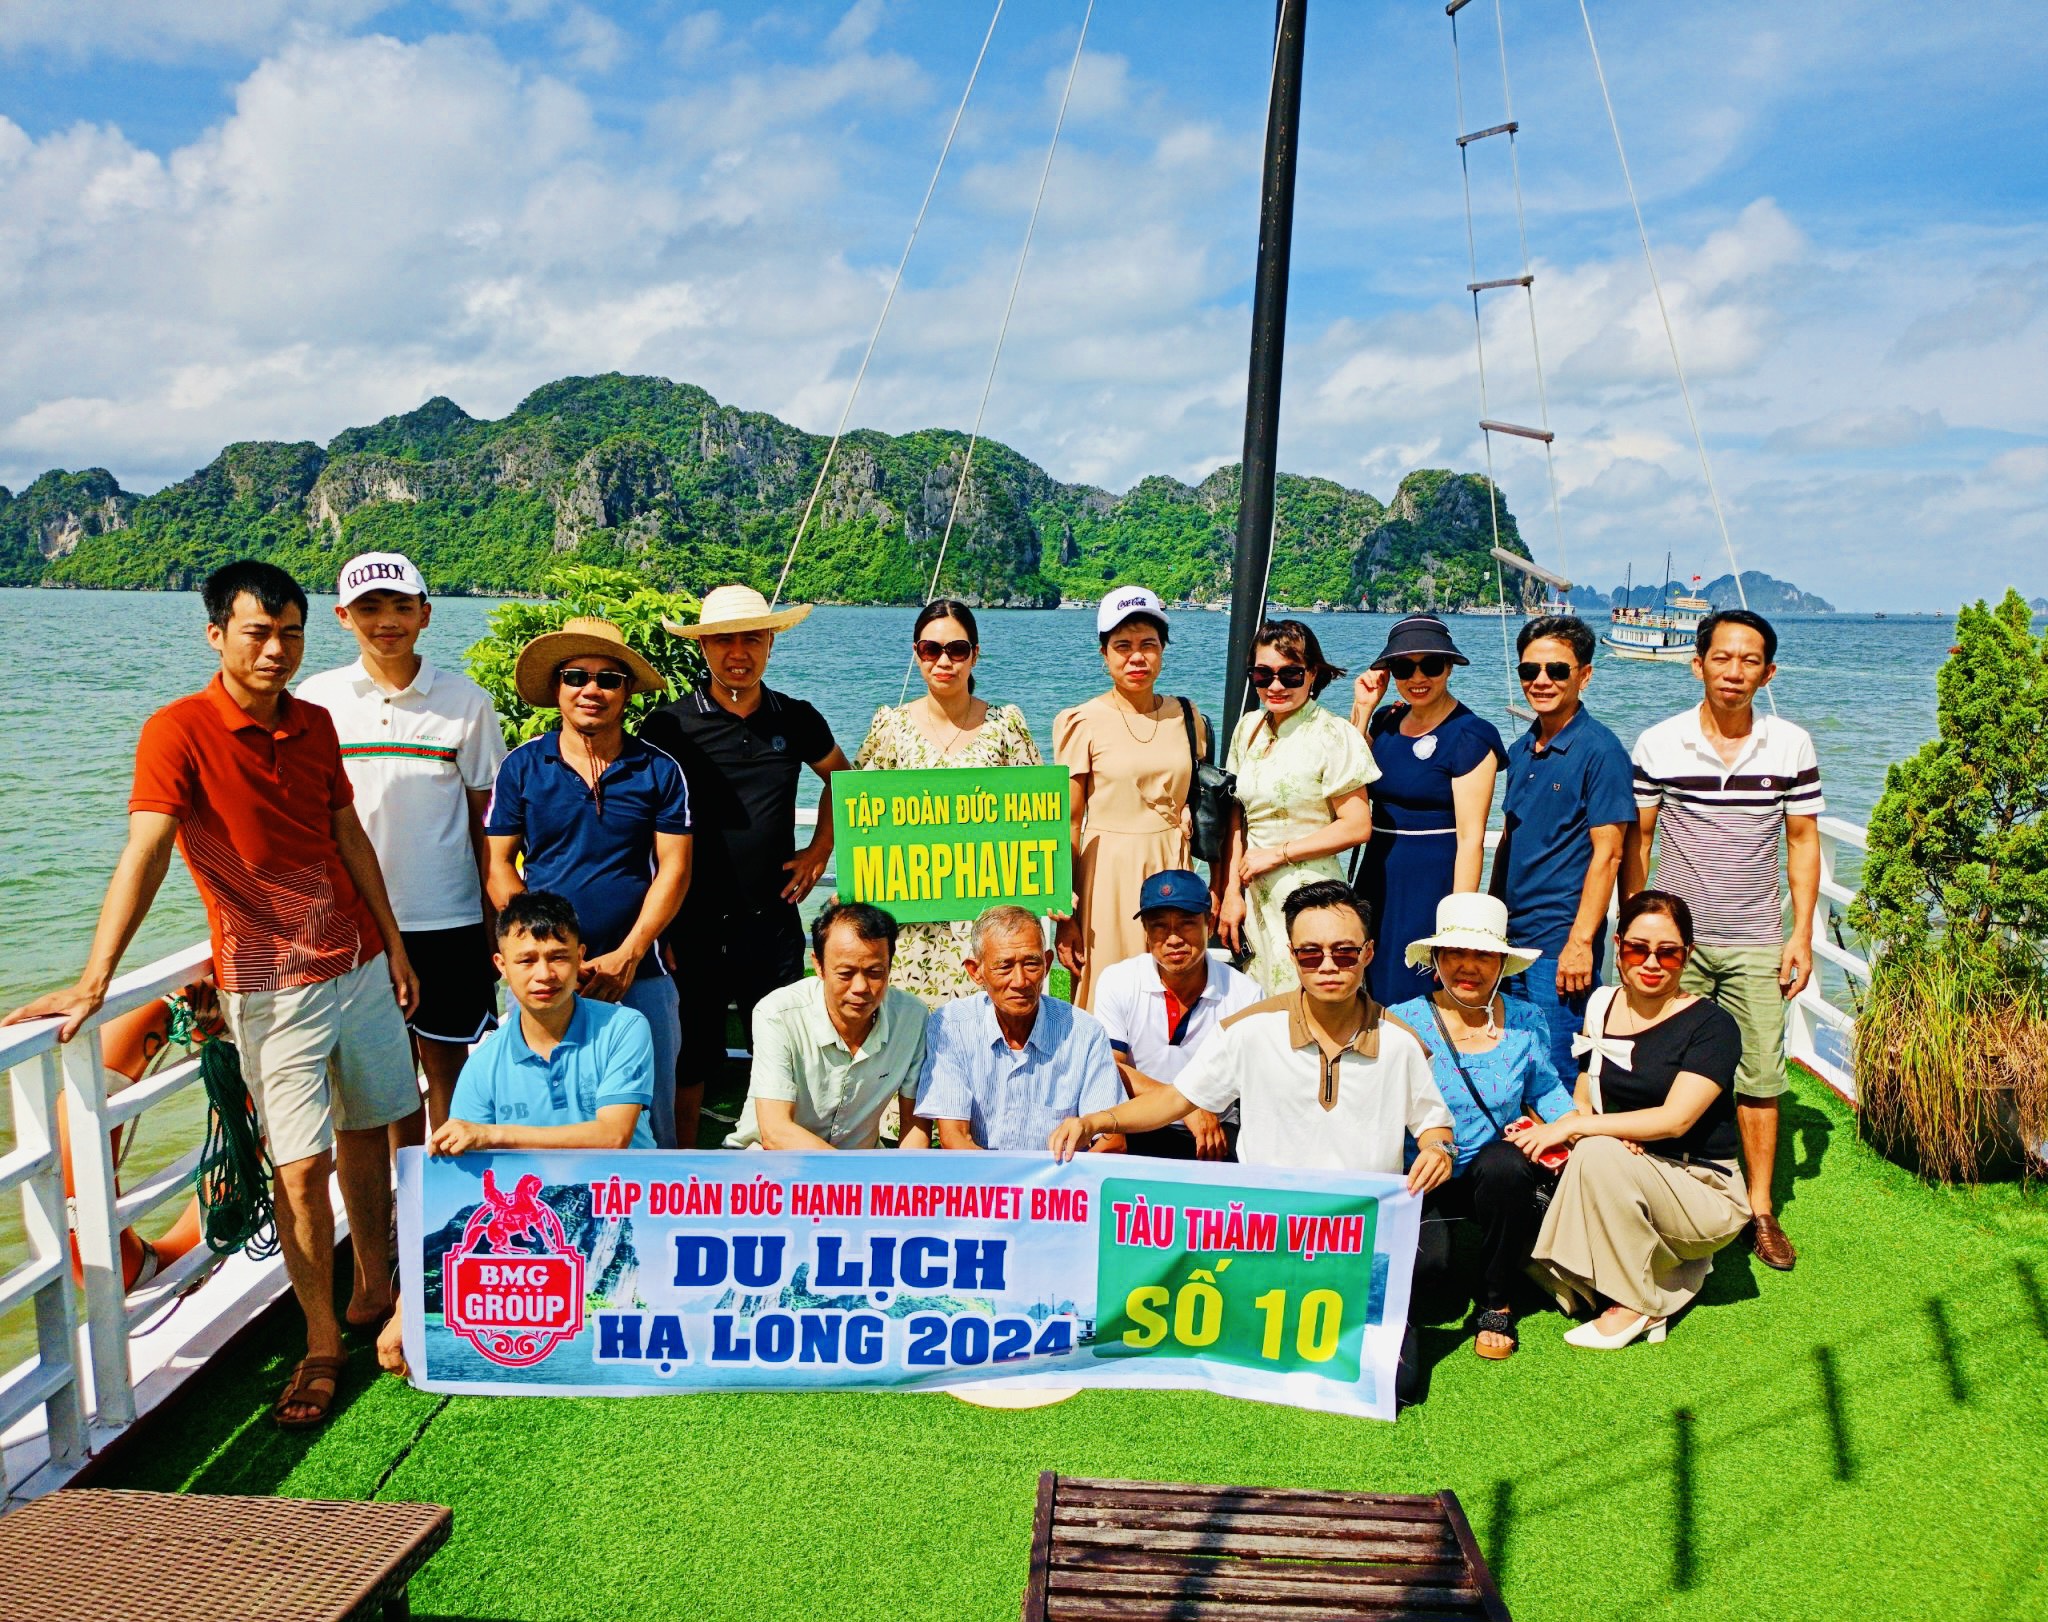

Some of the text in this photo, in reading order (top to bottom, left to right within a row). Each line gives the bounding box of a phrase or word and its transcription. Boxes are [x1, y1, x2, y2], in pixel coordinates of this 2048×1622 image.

[348, 563, 404, 588] GOODBOY
[845, 786, 1061, 834] TẬP ĐOÀN ĐỨC HẠNH
[853, 840, 1058, 903] MARPHAVET
[591, 1174, 1088, 1223] TẬP ĐOÀN ĐỨC HẠNH MARPHAVET BMG
[1113, 1195, 1365, 1260] TÀU THĂM VỊNH
[479, 1265, 550, 1287] BMG
[674, 1235, 1006, 1301] DU LỊCH
[465, 1293, 565, 1322] GROUP
[1123, 1258, 1343, 1363] SỐ 10
[599, 1315, 1073, 1373] HẠ LONG 2024
